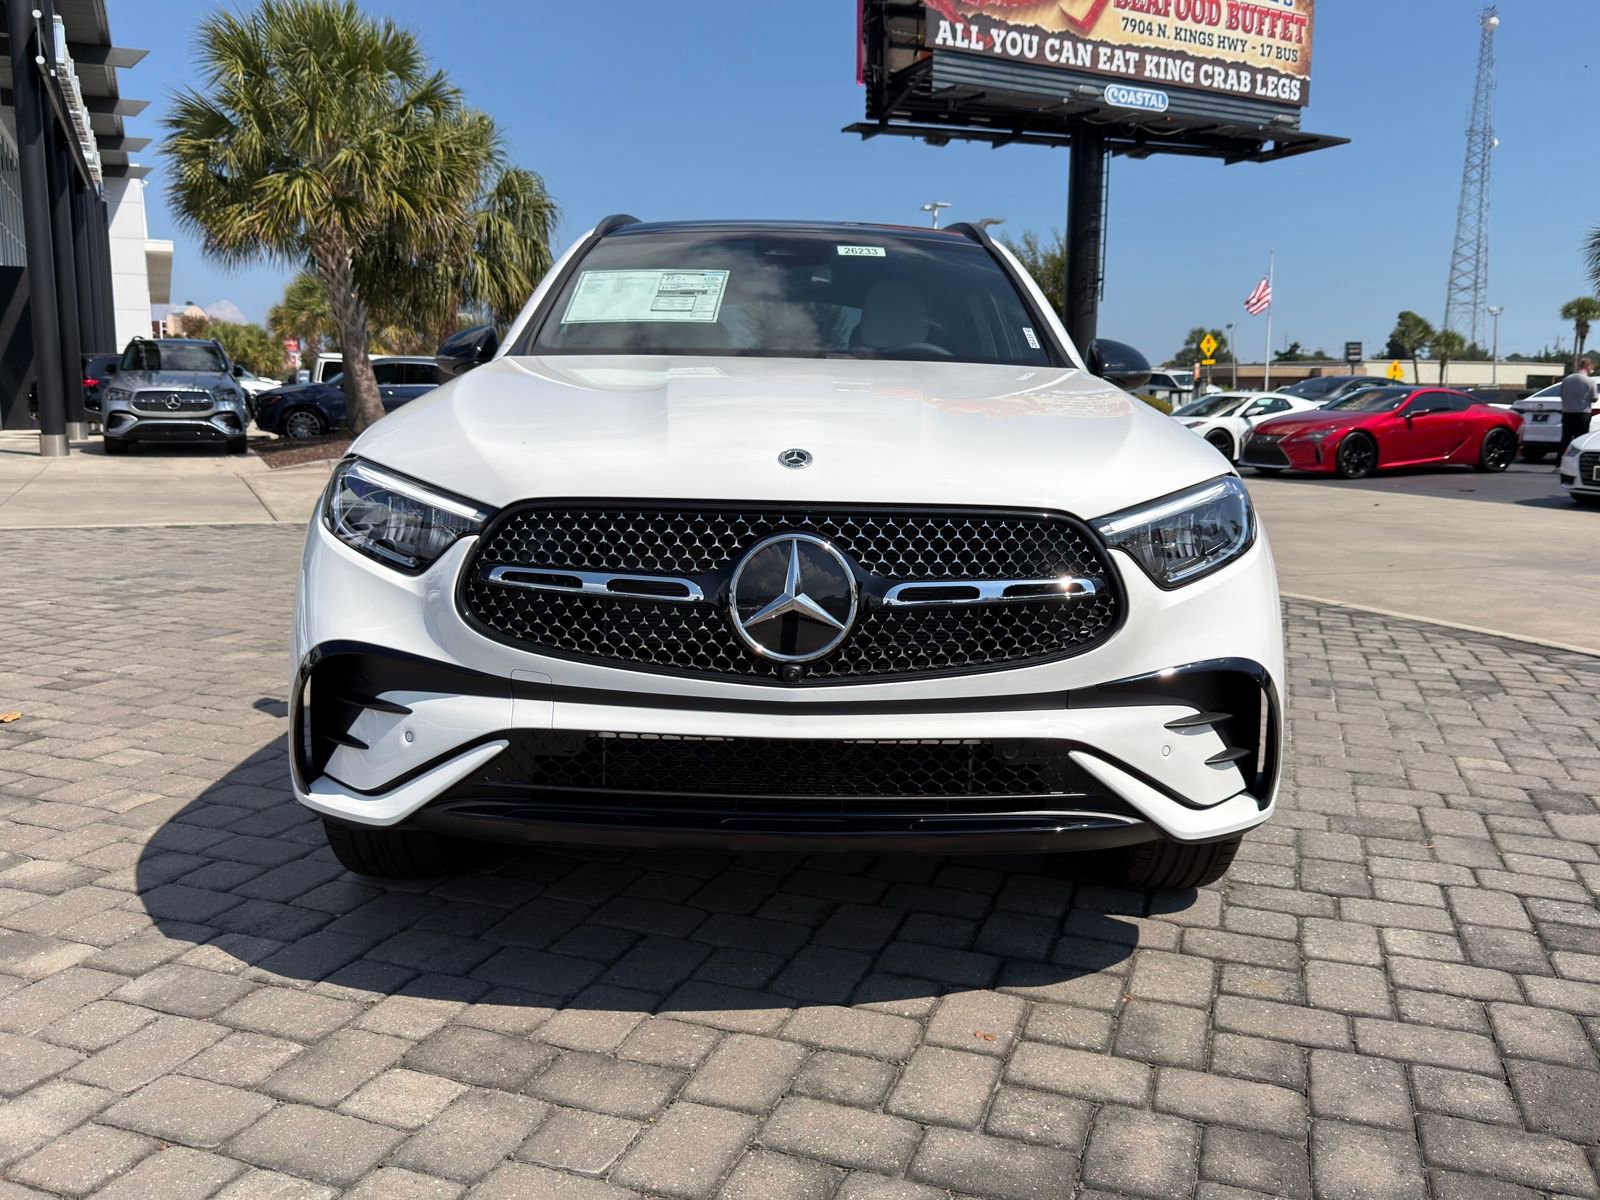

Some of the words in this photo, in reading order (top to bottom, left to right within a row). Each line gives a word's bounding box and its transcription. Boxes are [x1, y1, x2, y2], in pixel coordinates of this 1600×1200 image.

[1121, 17, 1154, 36] 7904
[1157, 24, 1170, 40] N.
[1174, 26, 1214, 47] KINGS
[1217, 34, 1248, 53] HWY
[1260, 43, 1273, 58] 17
[1275, 48, 1299, 63] BUS
[1225, 0, 1307, 44] BUFFET
[935, 19, 984, 51] ALL
[990, 27, 1039, 59] YOU
[1044, 37, 1093, 68] CAN
[1097, 46, 1139, 74] EAT
[1144, 54, 1195, 83] KING
[1200, 64, 1251, 93] CRAB
[1255, 73, 1301, 101] LEGS
[1107, 86, 1166, 109] COASTAL
[843, 247, 878, 256] 26233
